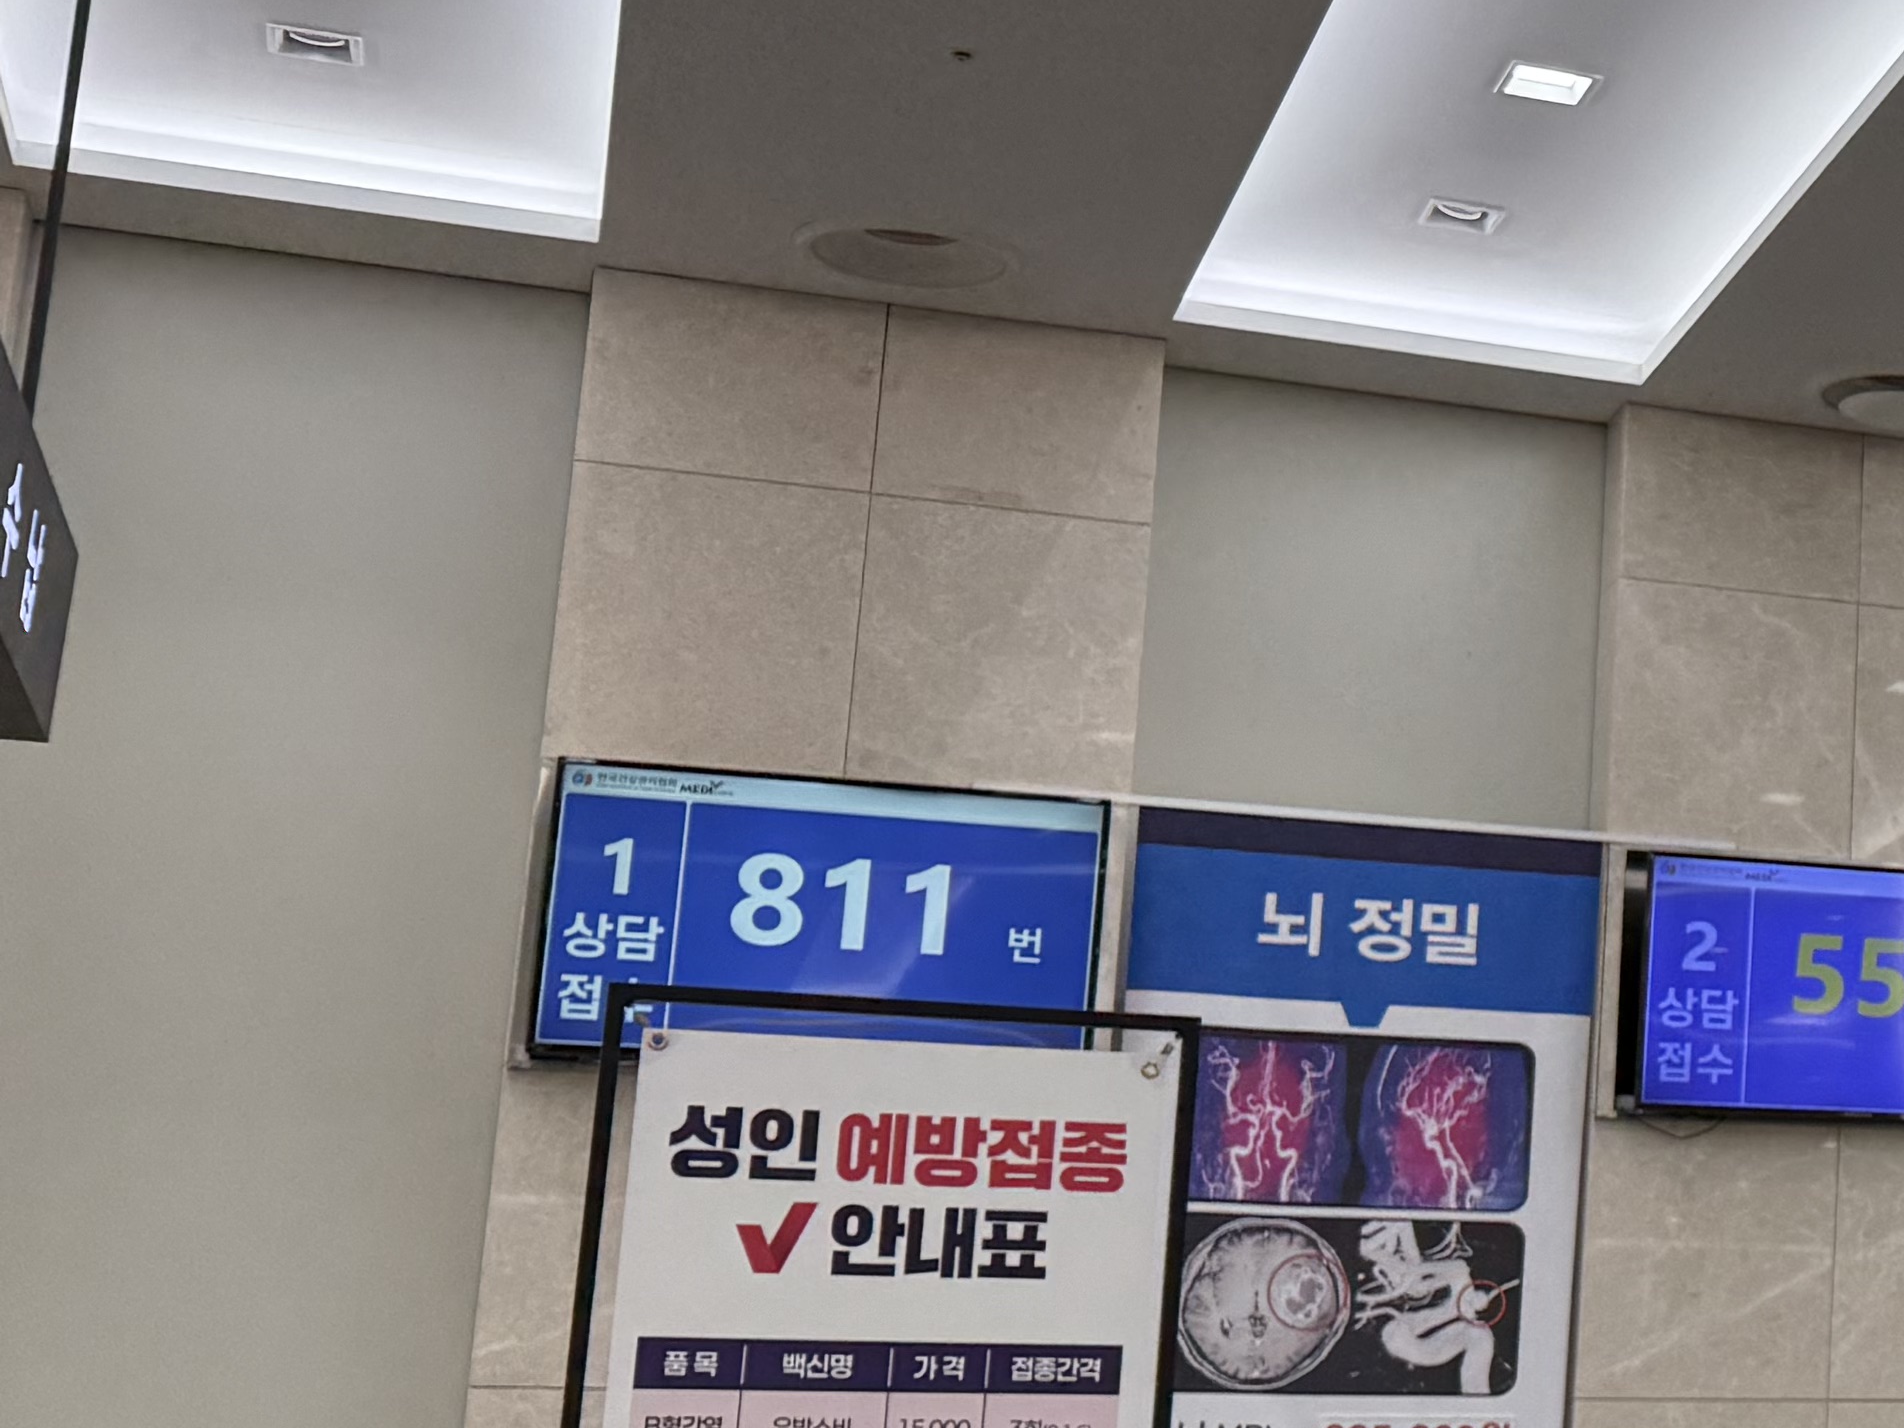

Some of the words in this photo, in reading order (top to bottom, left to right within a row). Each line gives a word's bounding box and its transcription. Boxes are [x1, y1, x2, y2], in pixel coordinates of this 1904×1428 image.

[603, 838, 634, 895] 1
[730, 853, 951, 955] 811
[1008, 928, 1042, 963] 번
[1257, 892, 1323, 956] 뇌
[1349, 898, 1479, 965] 정밀
[563, 913, 664, 961] 상담
[1681, 921, 1718, 972] 2
[557, 973, 652, 1020] 접
[1658, 988, 1739, 1030] 상담
[1657, 1042, 1734, 1085] 접수
[669, 1105, 820, 1181] 성인
[836, 1112, 1128, 1192] 예방접종
[830, 1204, 1048, 1279] 안내표
[782, 1353, 853, 1380] 백신명
[1011, 1357, 1102, 1383] 접종간격
